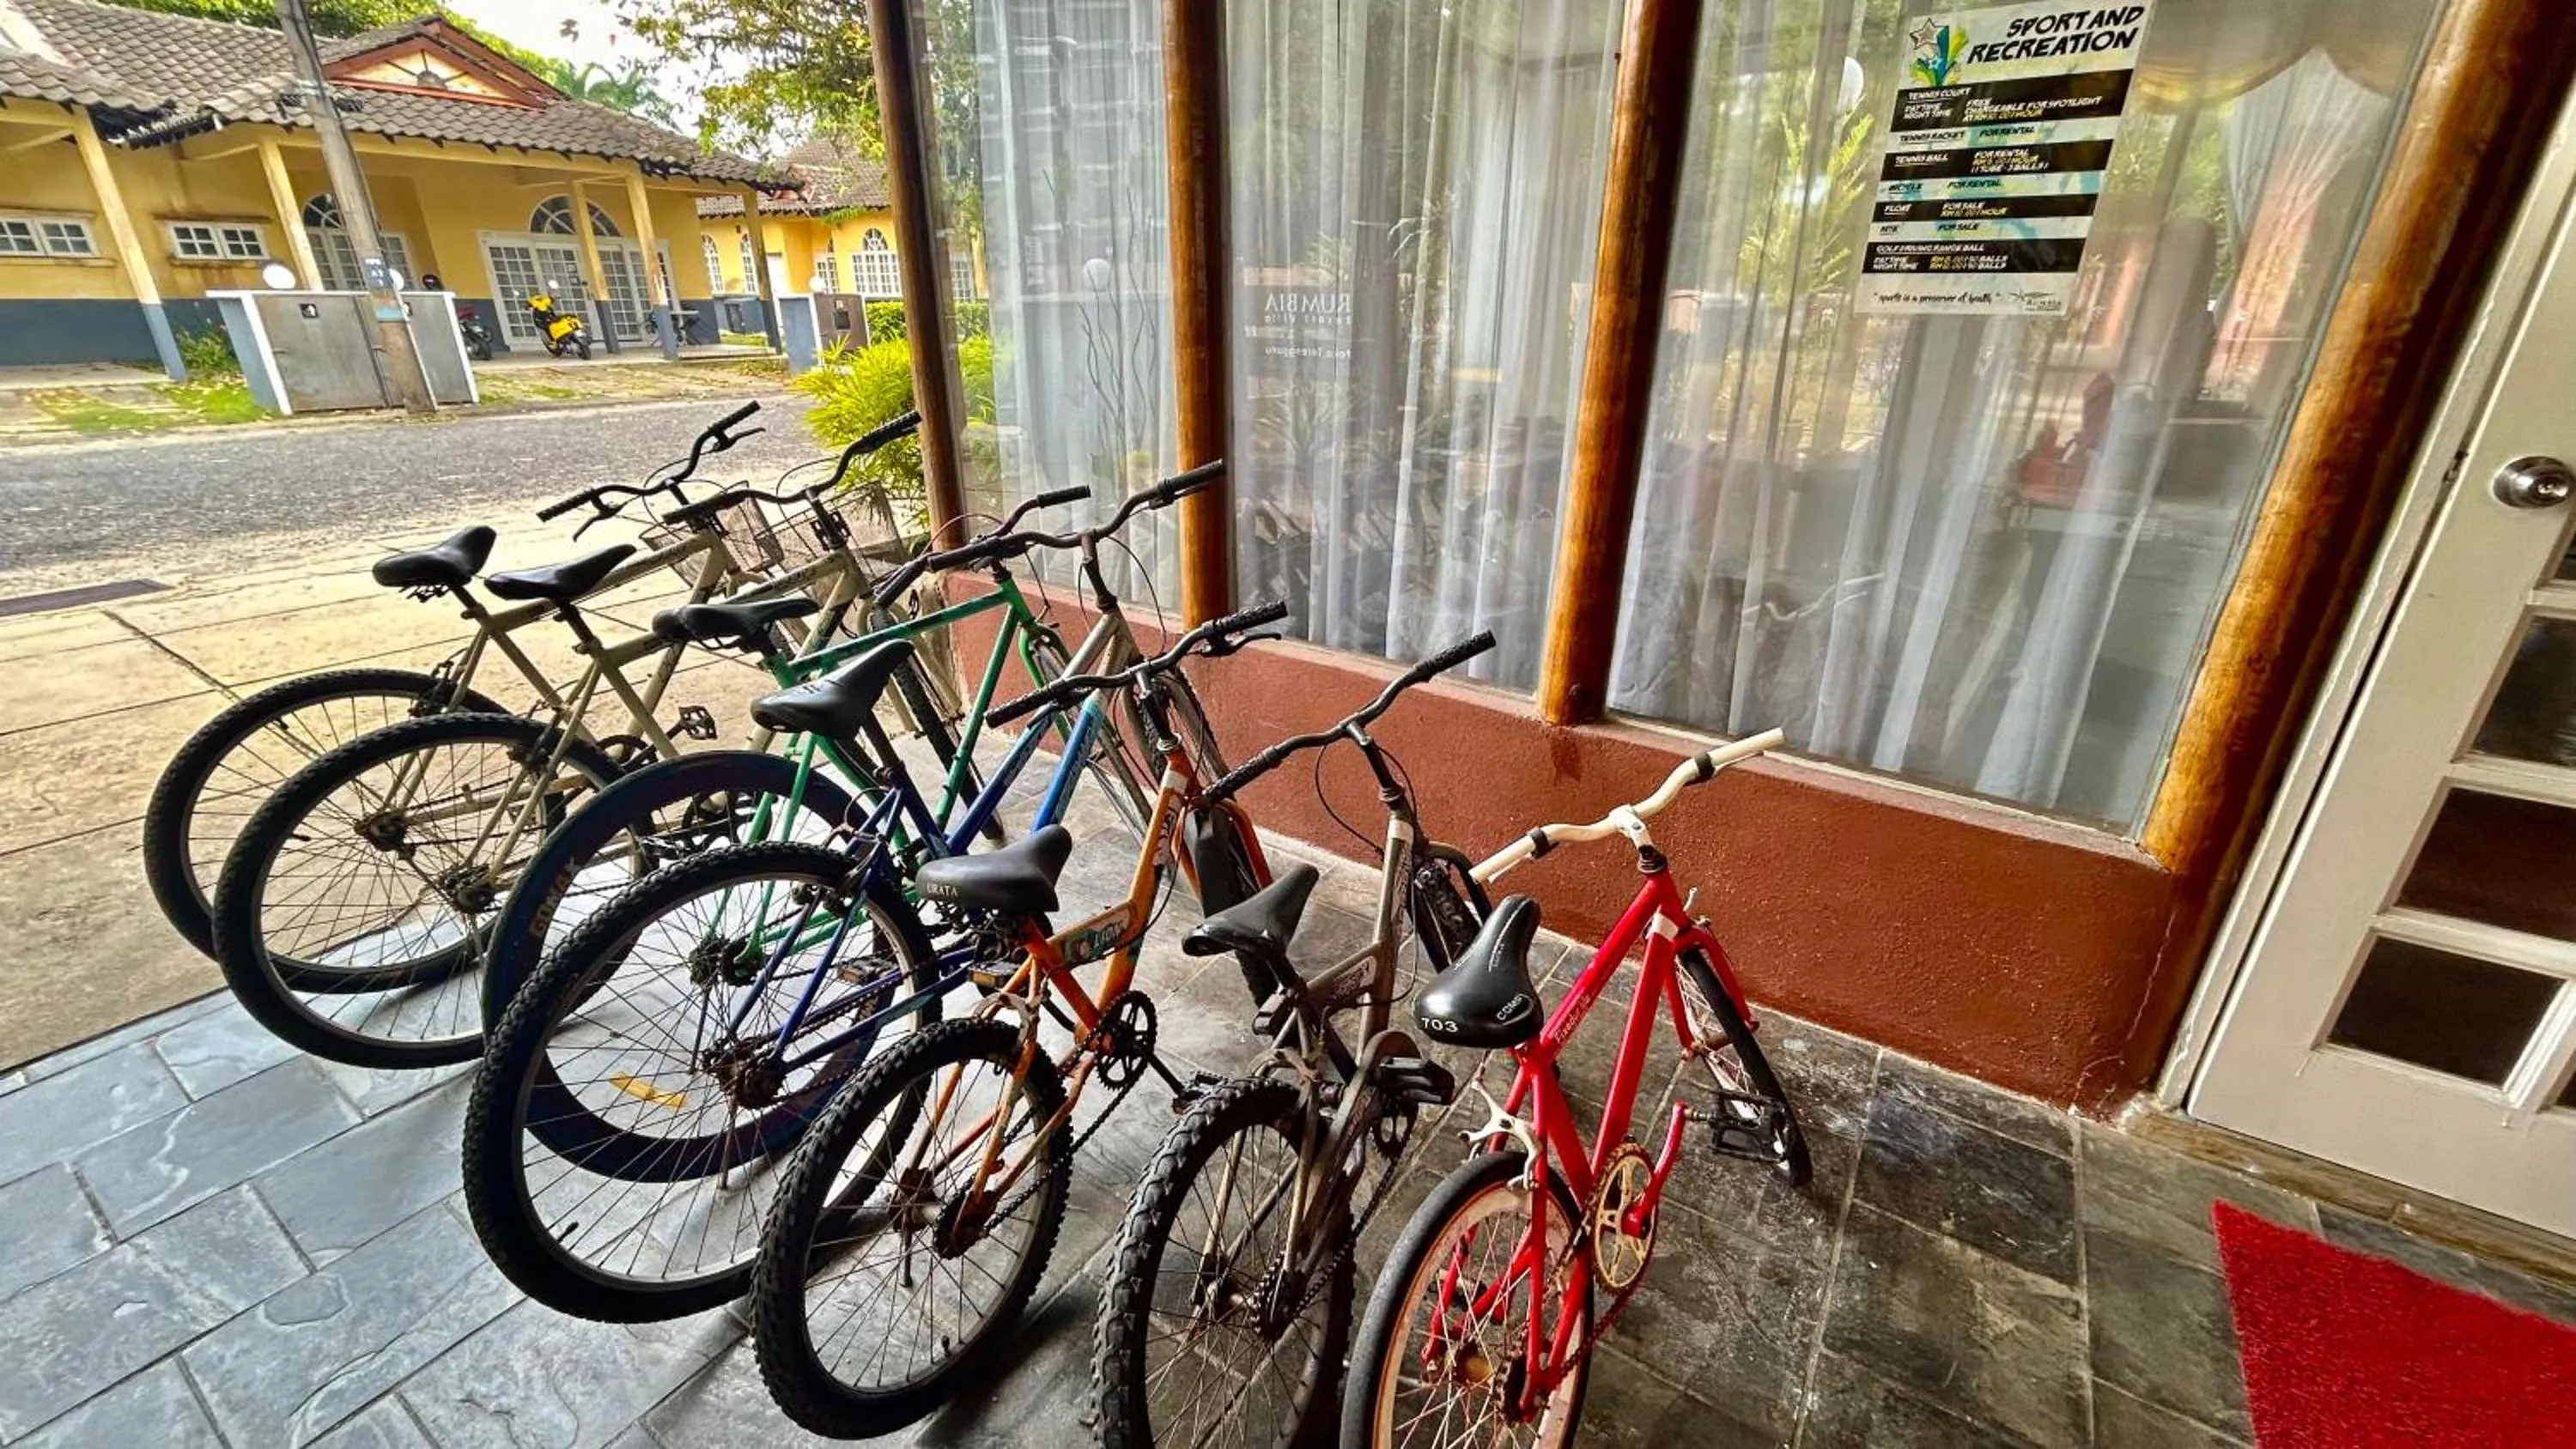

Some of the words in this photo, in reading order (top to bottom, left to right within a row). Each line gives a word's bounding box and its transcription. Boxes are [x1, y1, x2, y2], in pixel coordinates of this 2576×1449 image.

[2007, 10, 2087, 38] SPORT
[2085, 6, 2145, 28] AND
[1967, 27, 2138, 64] RECREATION
[1909, 91, 1940, 100] TENNIS
[1941, 88, 1971, 97] COURT
[1962, 243, 1985, 252] BALL
